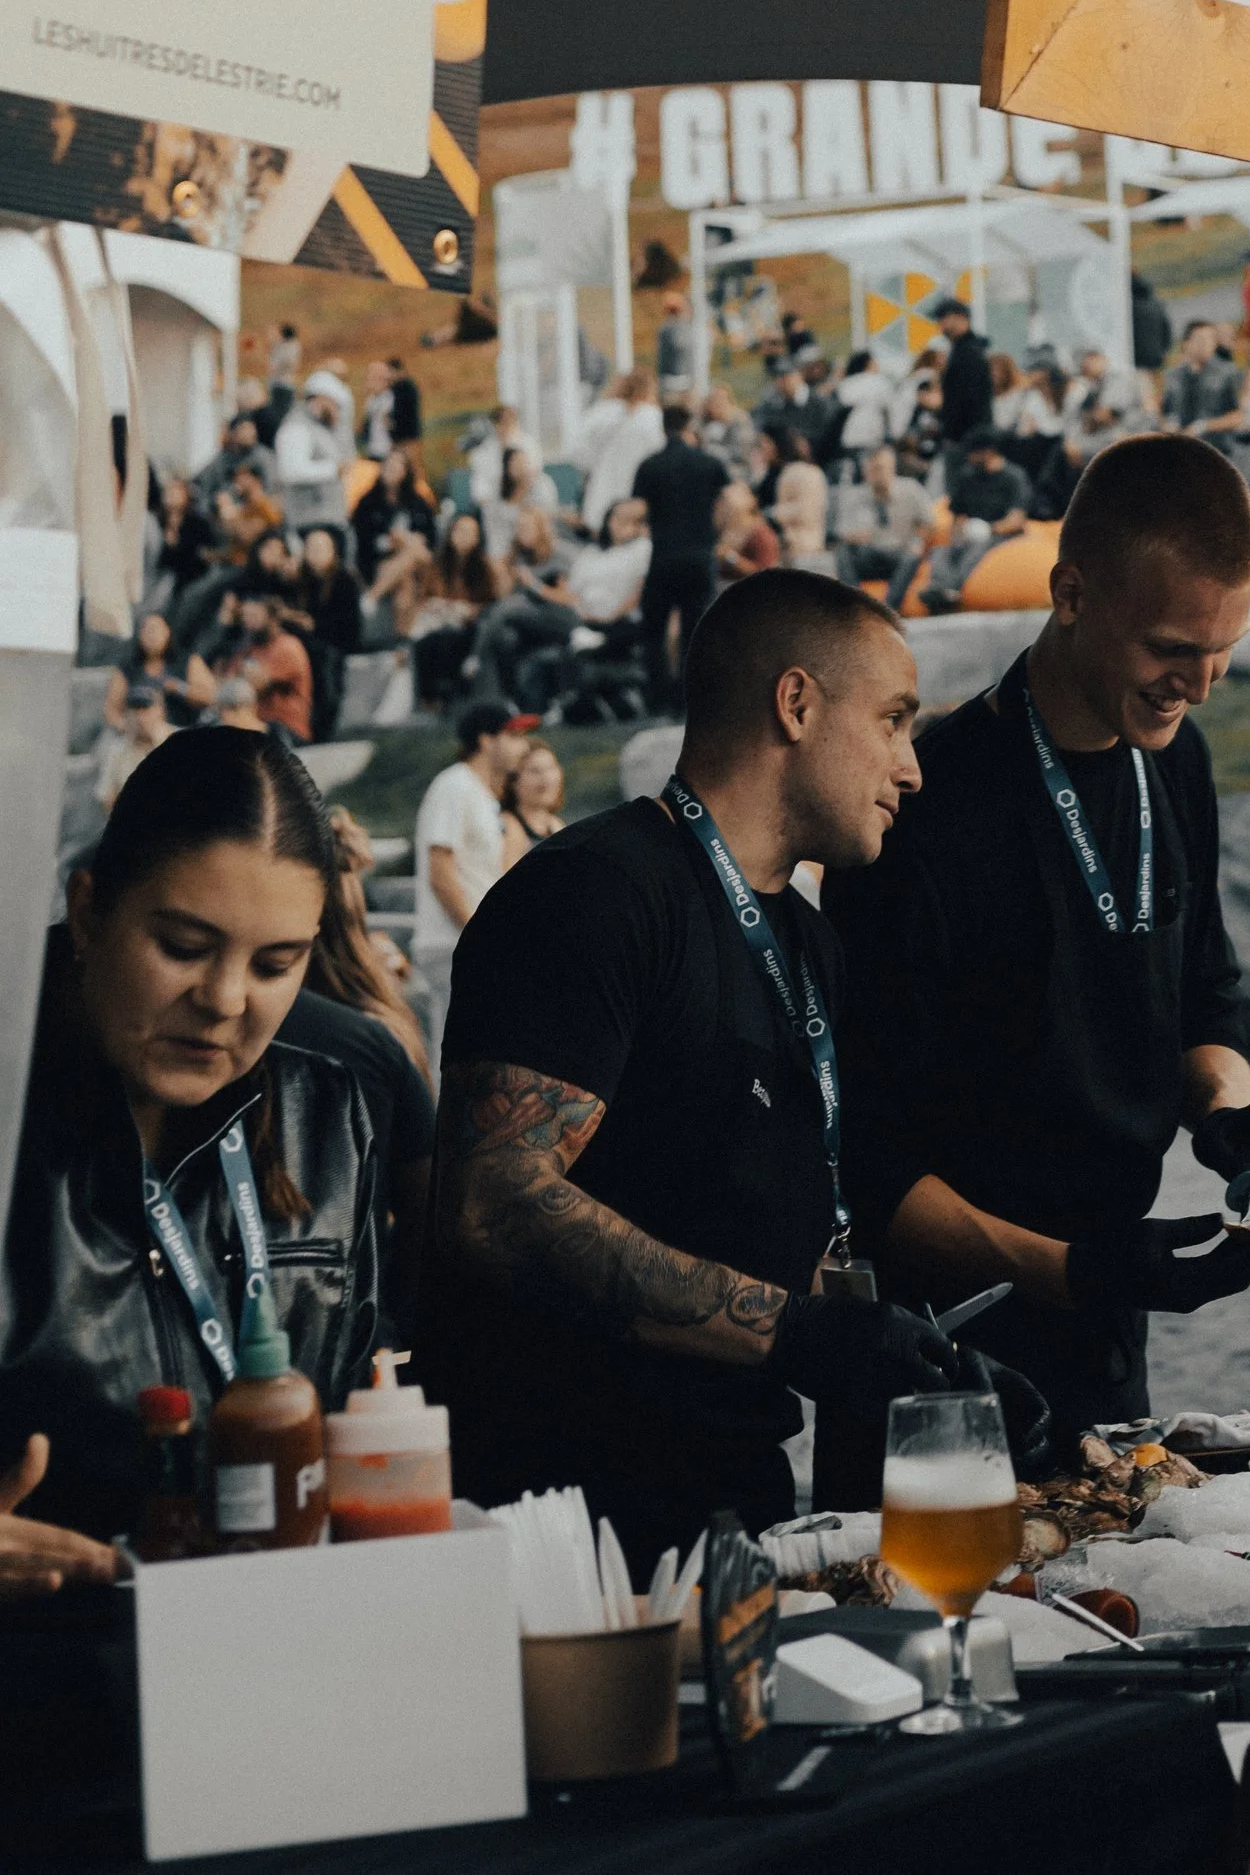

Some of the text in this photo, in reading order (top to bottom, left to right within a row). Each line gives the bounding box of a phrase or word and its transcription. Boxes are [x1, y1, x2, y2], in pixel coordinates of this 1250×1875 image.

[711, 838, 750, 907] Desjardins
[1066, 808, 1098, 874] Desjardins
[1138, 853, 1151, 919] Desjardins
[763, 949, 797, 1017] Desjardins
[151, 1201, 201, 1291] Desjardins
